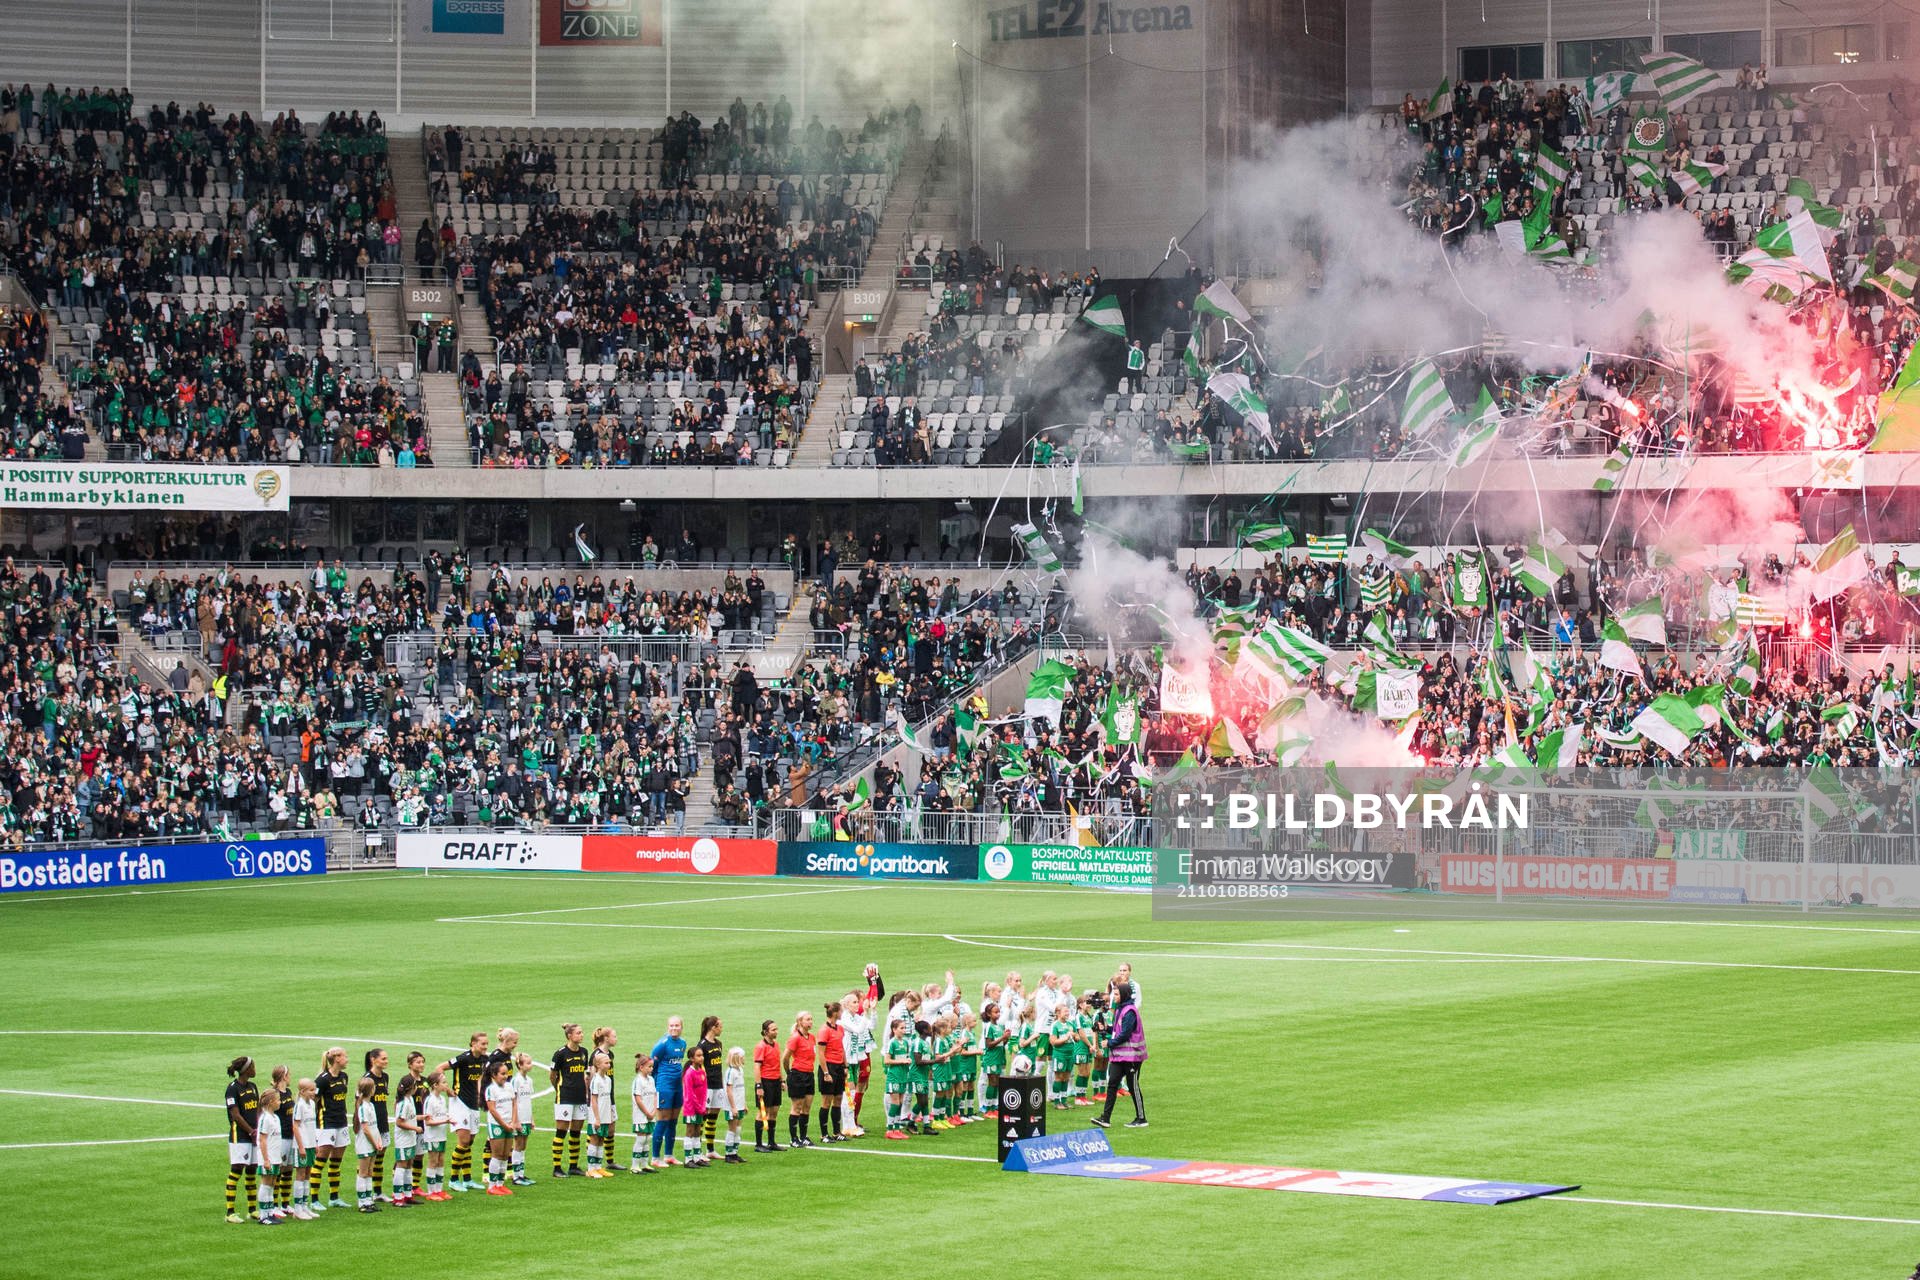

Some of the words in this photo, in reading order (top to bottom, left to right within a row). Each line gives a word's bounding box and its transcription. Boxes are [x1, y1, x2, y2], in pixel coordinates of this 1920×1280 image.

[448, 2, 504, 12] EXPRESS
[563, 15, 640, 37] ZONE
[987, 0, 1085, 41] TELE2
[1092, 4, 1193, 35] Arena
[412, 290, 442, 302] B302
[854, 293, 881, 304] B301
[9, 469, 74, 483] POSITIV
[79, 470, 247, 486] SUPPORTERKULTUR
[5, 487, 185, 506] Hammarbyklanen
[760, 656, 790, 668] A101
[443, 842, 518, 861] CRAFT
[636, 848, 691, 862] marginalen
[1031, 848, 1092, 860] BOSPHORUS
[1095, 850, 1158, 862] MATKLUSTER
[1, 853, 112, 888] Bostäder
[117, 851, 166, 881] från
[257, 849, 312, 875] OBOS
[806, 853, 858, 873] Sefina
[869, 853, 949, 875] pantbank
[1031, 860, 1076, 872] OFFICIELL
[1079, 861, 1158, 874] MATLEVERANTÖR
[1031, 872, 1046, 880] TILL
[1048, 873, 1089, 883] HAMMARBY
[1092, 875, 1129, 884] FOTBOLLS
[1131, 876, 1158, 885] DAMER
[1447, 861, 1518, 887] HUSKI
[1523, 863, 1670, 891] CHOCOLATE
[1733, 865, 1895, 902] limitado
[1041, 1147, 1067, 1160] OBOS
[1083, 1140, 1109, 1154] OBOS
